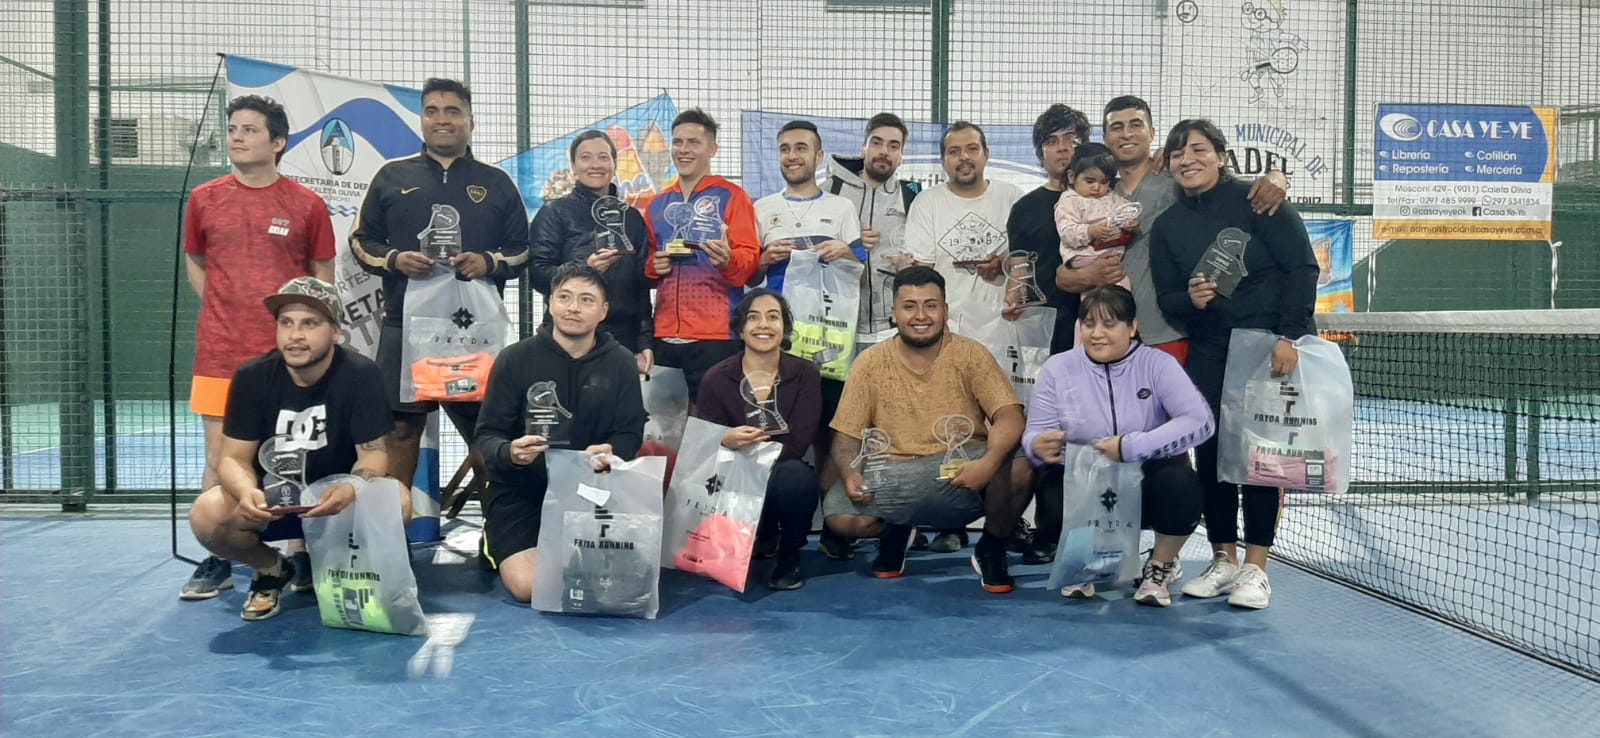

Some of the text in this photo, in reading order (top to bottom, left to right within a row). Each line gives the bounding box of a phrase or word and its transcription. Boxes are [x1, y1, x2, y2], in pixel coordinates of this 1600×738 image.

[1427, 119, 1533, 140] CASA YE-YE
[1235, 123, 1329, 180] MUNICIPAL DE
[1392, 150, 1431, 160] Librería
[1476, 151, 1517, 161] Cotillón
[1392, 164, 1449, 175] Repostería
[1476, 164, 1523, 175] Mercería
[1395, 185, 1430, 193] Mosconi
[1432, 185, 1447, 193] 429
[1454, 185, 1479, 195] (9011)
[1482, 186, 1509, 194] Caleta
[1511, 186, 1533, 194] Olivia
[1483, 208, 1501, 216] Casa
